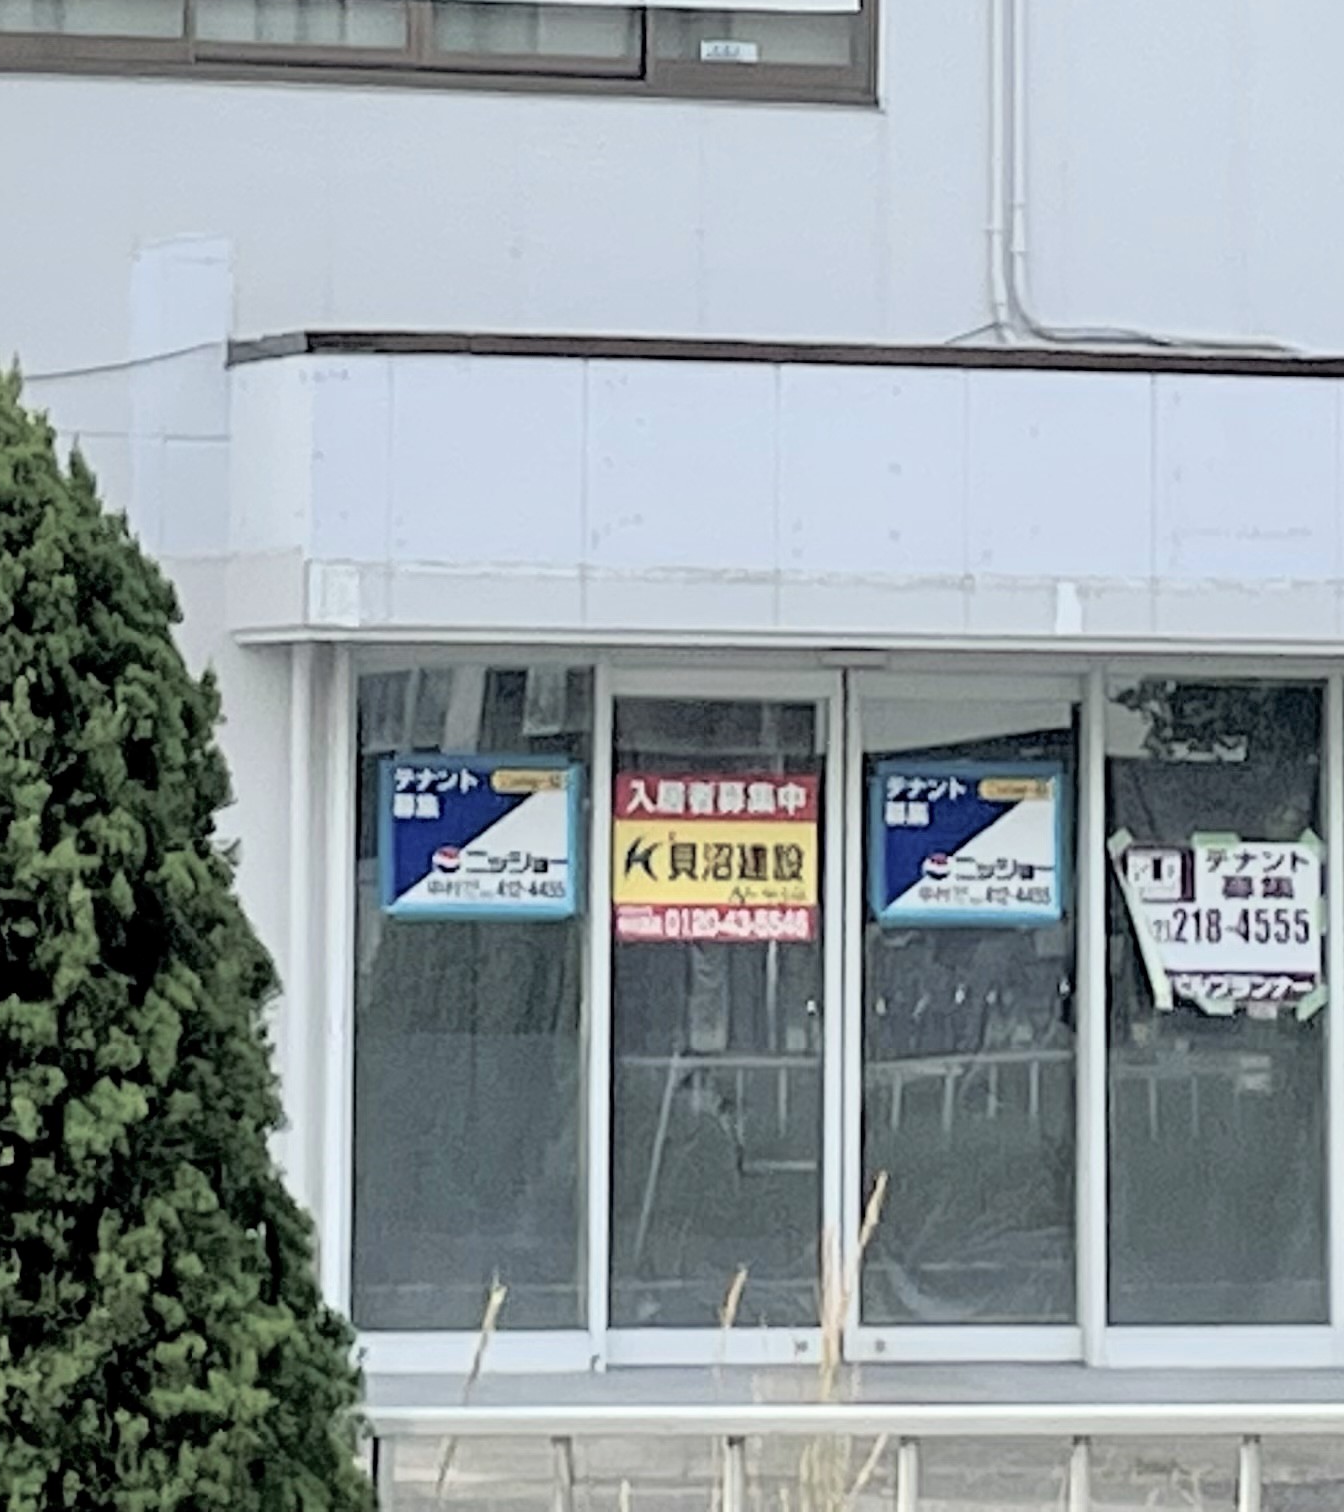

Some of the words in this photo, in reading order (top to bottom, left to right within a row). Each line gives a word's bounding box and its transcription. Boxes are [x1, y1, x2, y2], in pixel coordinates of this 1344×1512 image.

[394, 767, 479, 794] テナント
[886, 775, 967, 801] テナント
[1206, 849, 1309, 873] テナント
